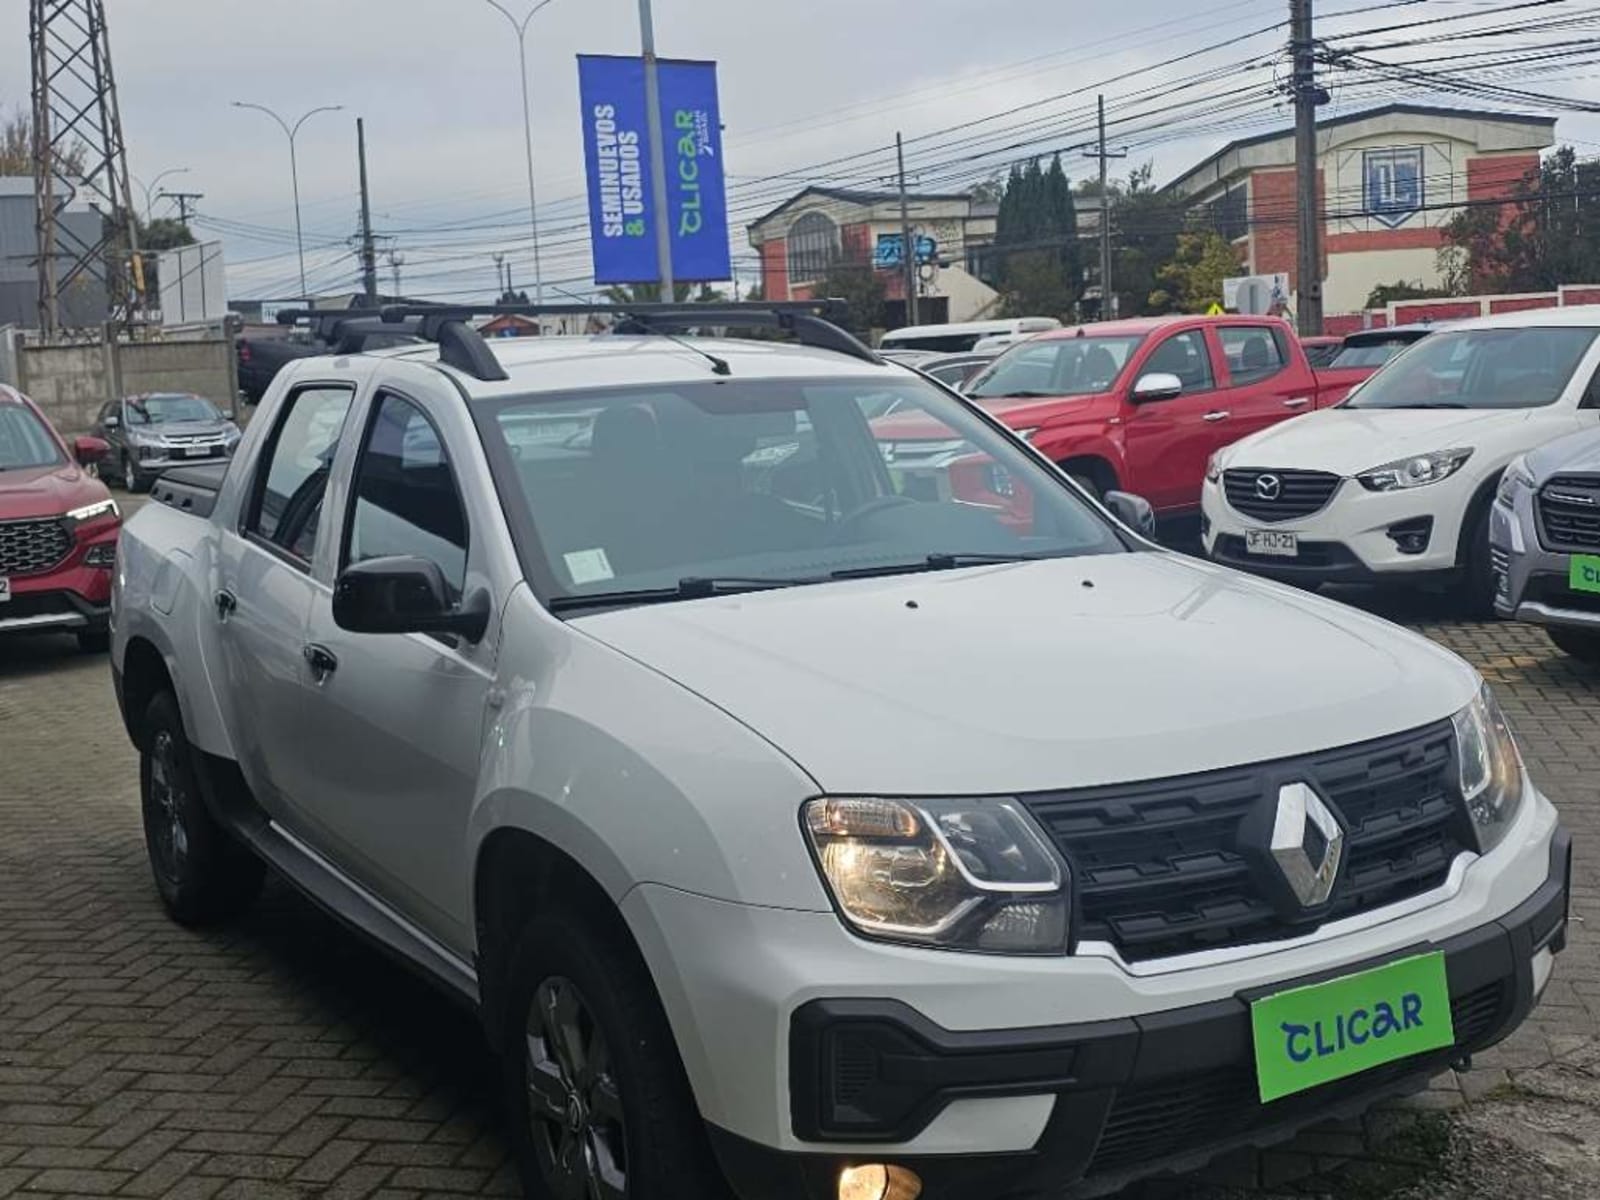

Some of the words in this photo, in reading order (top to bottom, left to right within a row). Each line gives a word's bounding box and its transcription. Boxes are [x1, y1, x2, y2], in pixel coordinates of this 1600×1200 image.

[594, 104, 623, 237] SEMINUEVOS
[618, 131, 644, 215] USADOS
[626, 219, 645, 236] &
